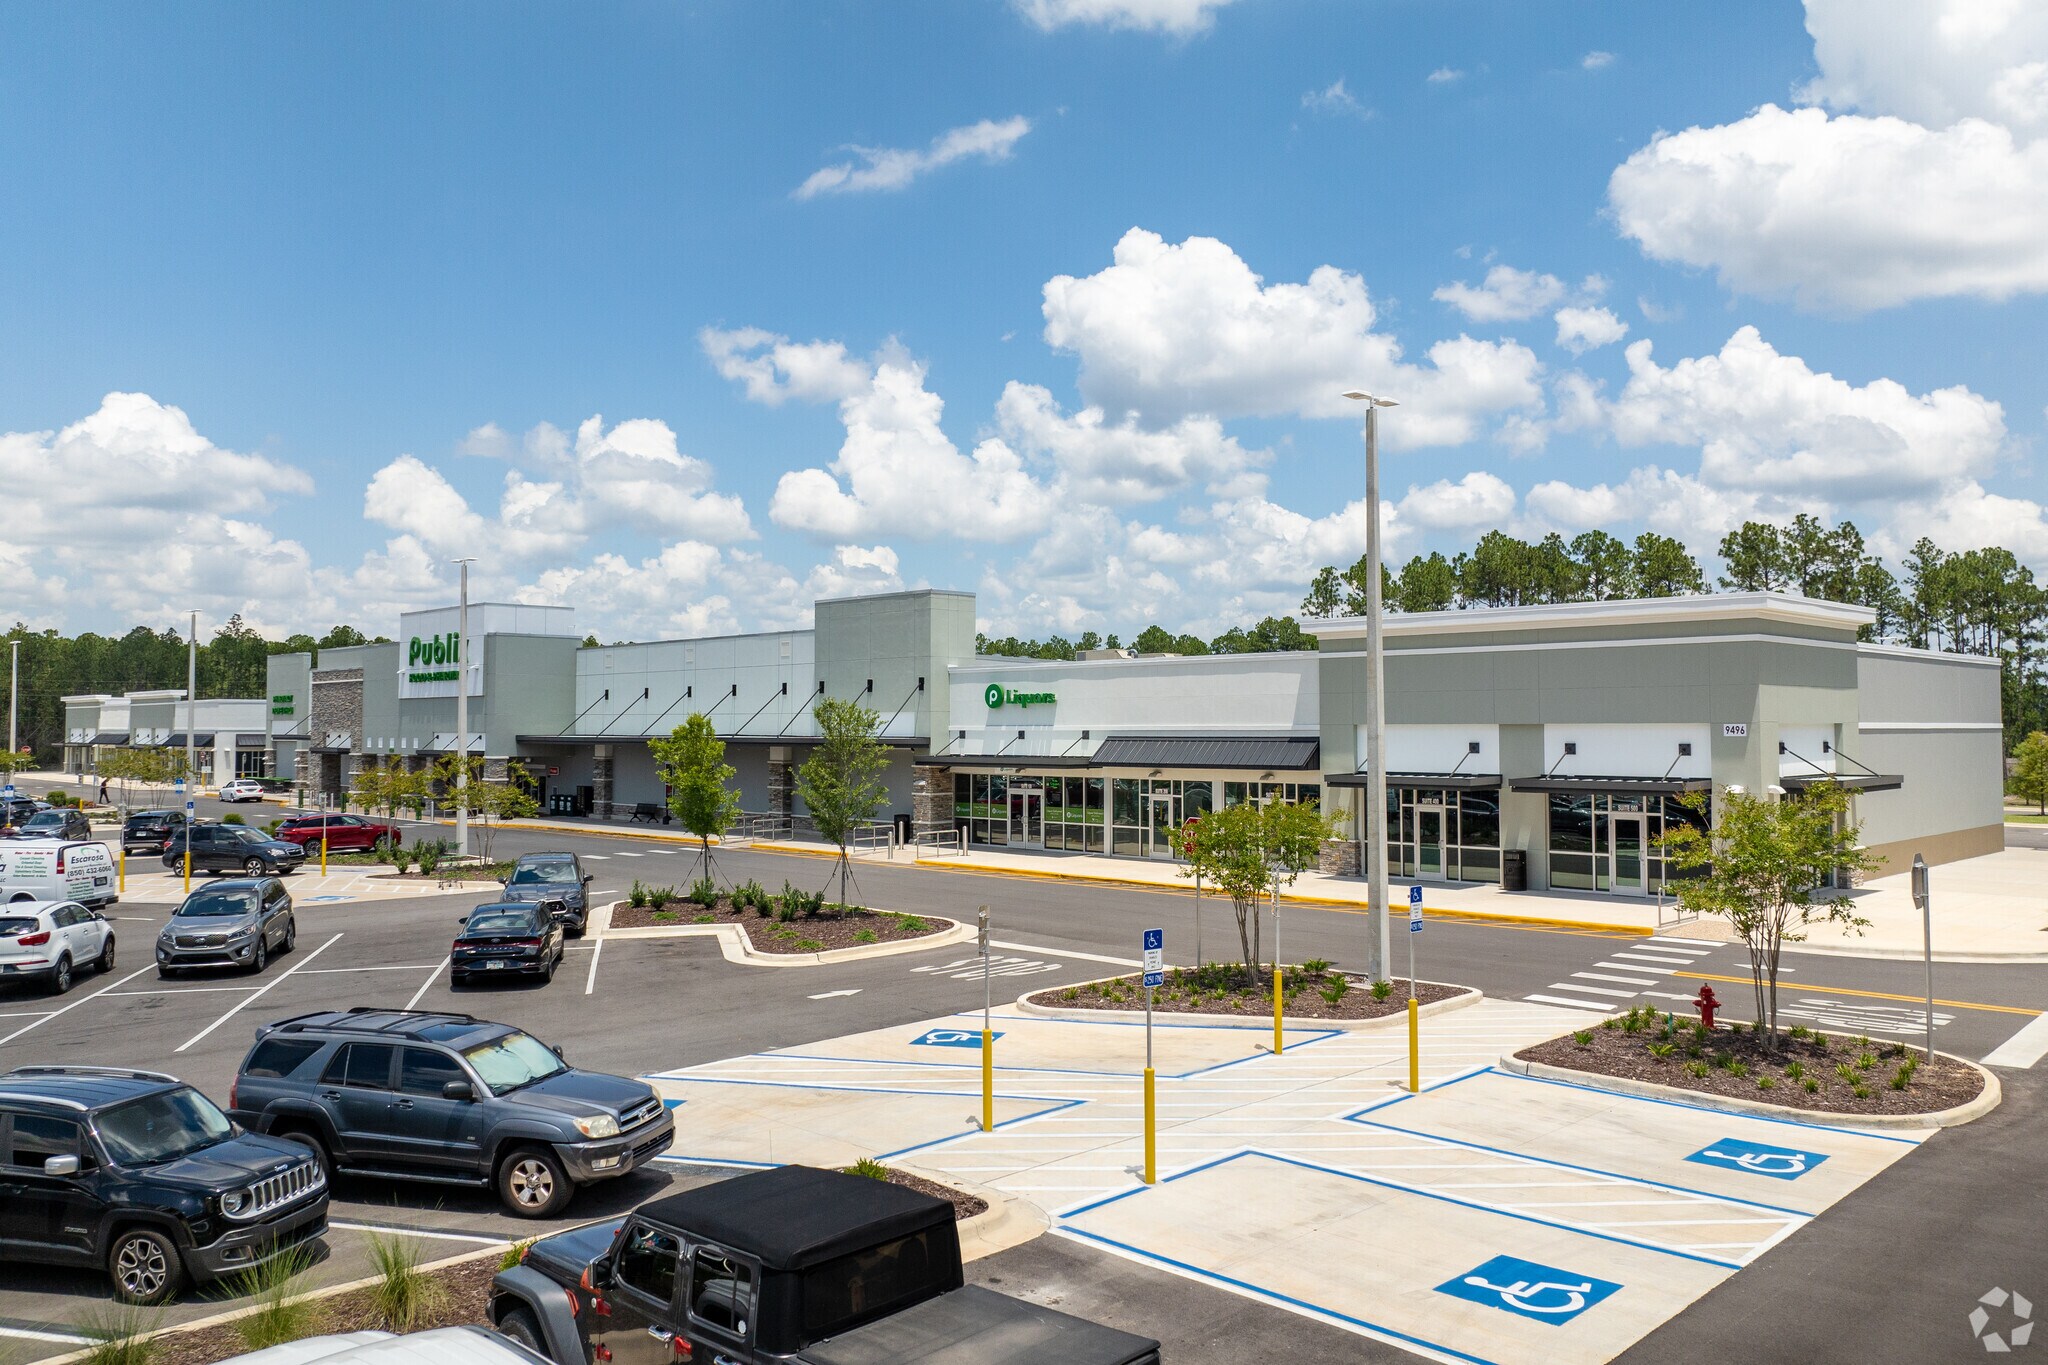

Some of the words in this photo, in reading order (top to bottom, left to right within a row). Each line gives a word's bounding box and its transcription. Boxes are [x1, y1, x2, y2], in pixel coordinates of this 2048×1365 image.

[409, 632, 469, 666] Publi
[1006, 690, 1056, 708] Liquors
[1725, 725, 1745, 735] 9496
